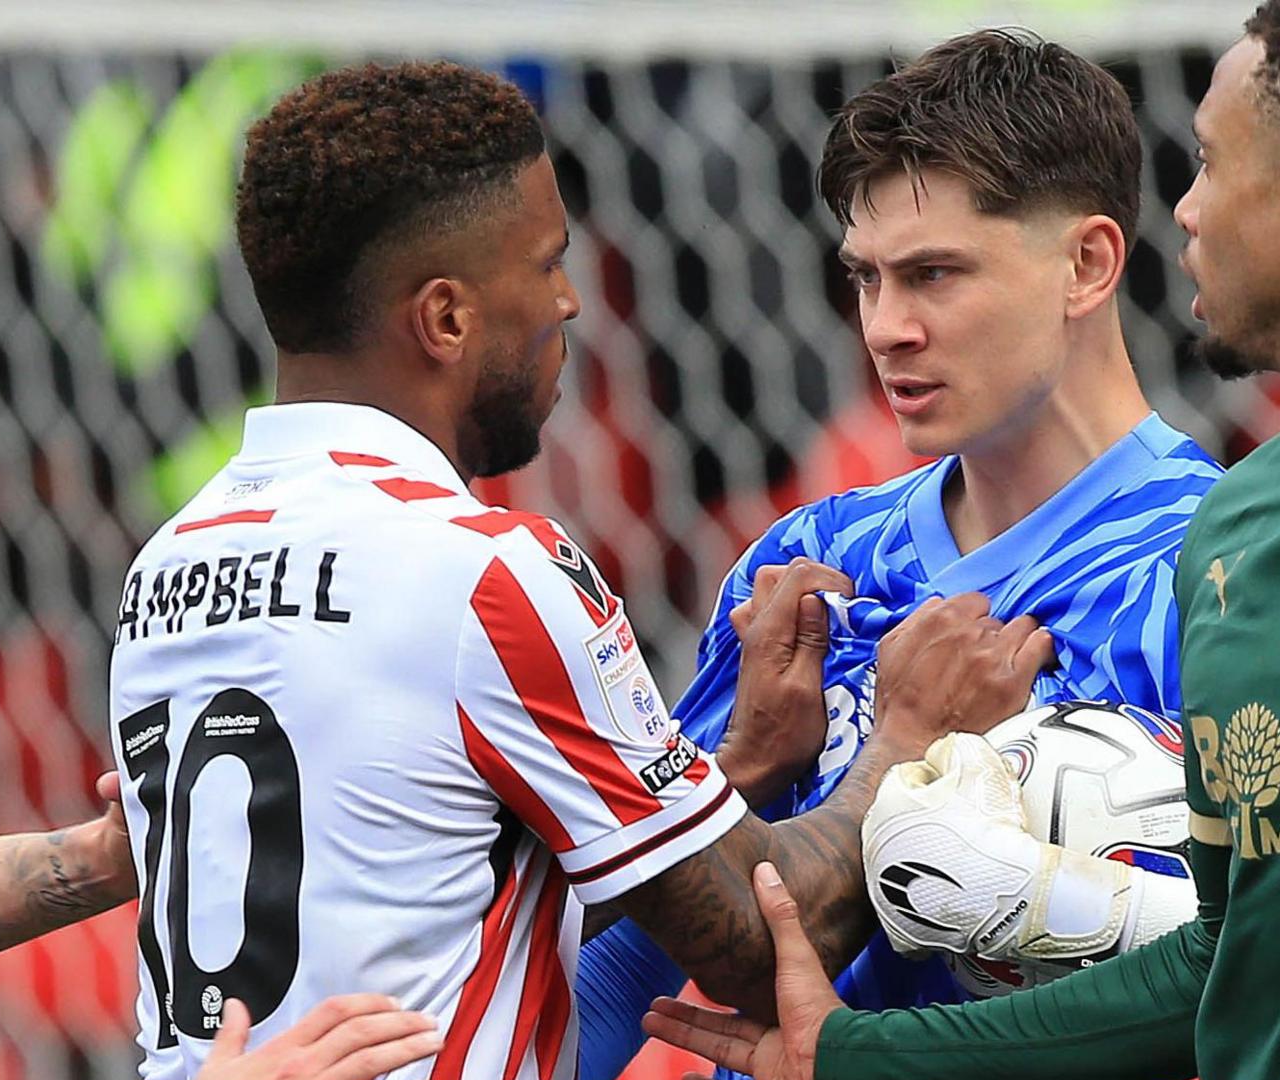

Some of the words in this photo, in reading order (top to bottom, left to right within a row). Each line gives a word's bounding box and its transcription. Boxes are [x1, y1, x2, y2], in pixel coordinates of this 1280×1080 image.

[117, 547, 351, 645] AMPBELL
[596, 640, 620, 666] sky
[644, 716, 665, 736] EFL
[118, 686, 303, 1050] 10
